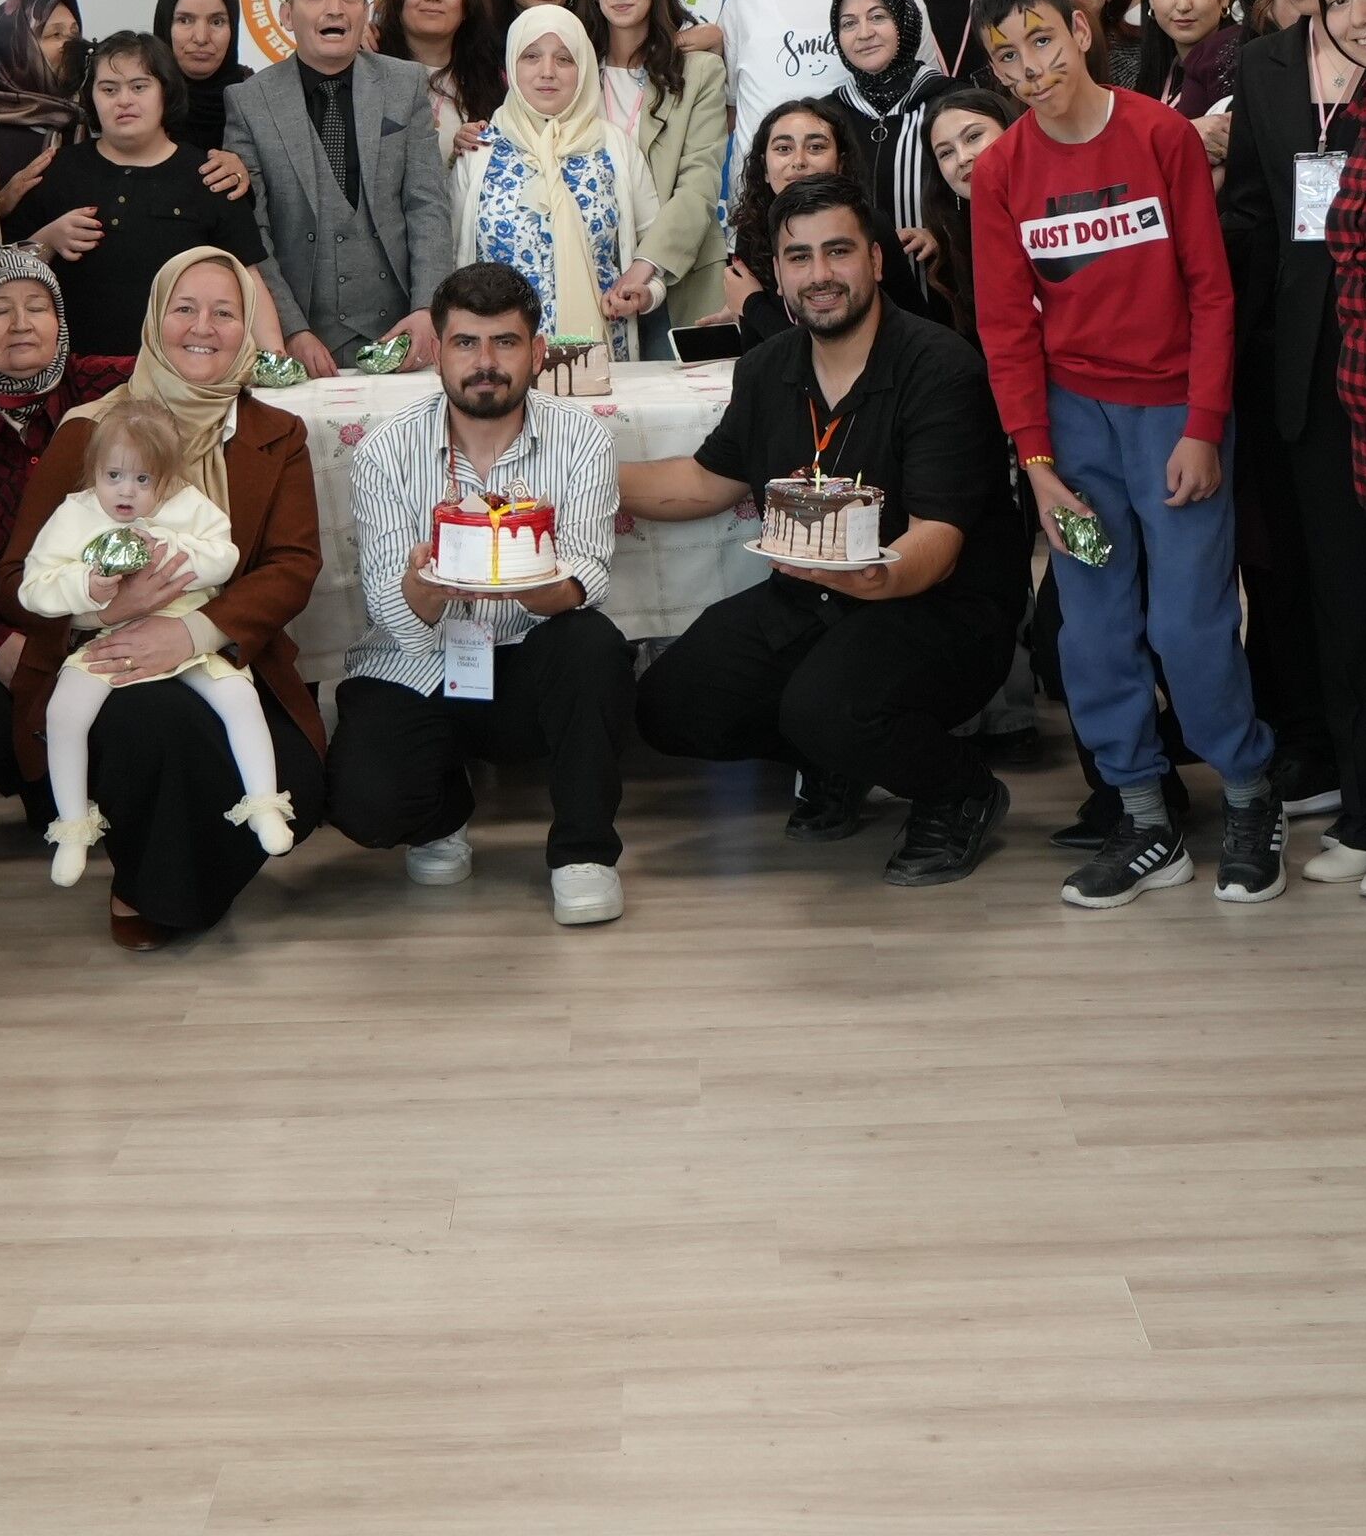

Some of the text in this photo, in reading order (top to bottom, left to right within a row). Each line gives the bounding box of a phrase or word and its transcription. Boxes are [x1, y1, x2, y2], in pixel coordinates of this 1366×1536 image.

[1029, 212, 1138, 249] JUST DO IT.
